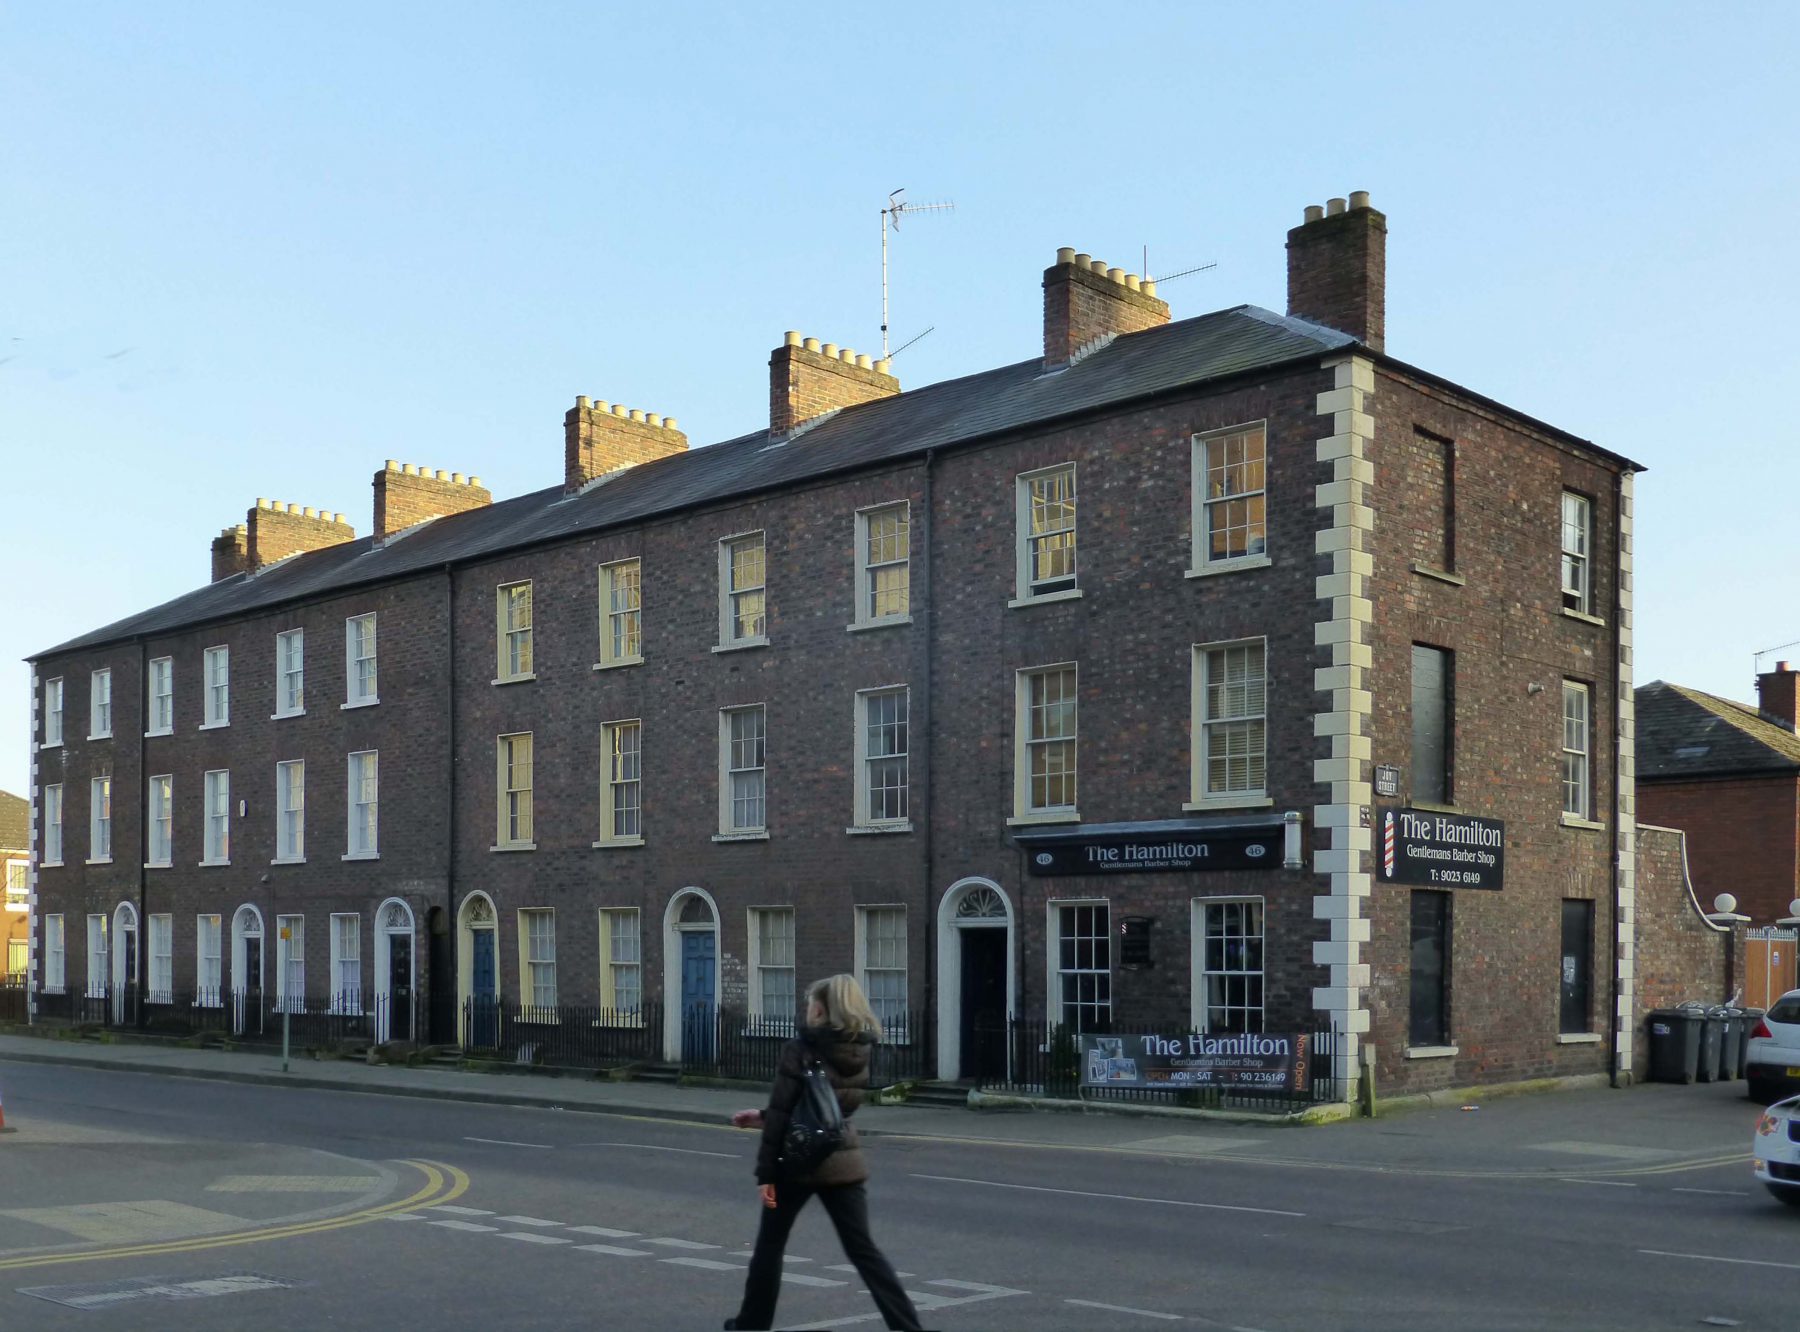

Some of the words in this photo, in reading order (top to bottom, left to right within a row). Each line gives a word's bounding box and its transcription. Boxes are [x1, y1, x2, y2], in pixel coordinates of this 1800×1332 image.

[1382, 771, 1392, 781] JOY
[1378, 781, 1396, 792] STREET
[1400, 813, 1431, 840] The
[1435, 817, 1502, 847] Hamilton
[1086, 846, 1118, 861] The
[1125, 842, 1208, 860] Hamilton
[1248, 845, 1262, 856] 46
[1407, 844, 1451, 860] Gentlemans
[1452, 849, 1476, 863] Barber
[1477, 851, 1495, 867] Shop
[1038, 854, 1051, 864] 46
[1100, 860, 1143, 869] Gentlemans
[1144, 859, 1169, 868] Barber
[1171, 858, 1191, 867] Shop
[1441, 870, 1461, 882] 9023
[1463, 871, 1480, 883] 6149
[1140, 1035, 1182, 1055] The
[1189, 1034, 1289, 1056] Hamilton
[1297, 1034, 1305, 1058] Now
[1215, 1058, 1241, 1066] Barber
[1243, 1058, 1263, 1069] Shop
[1171, 1072, 1190, 1080] MON
[1197, 1072, 1213, 1080] SAT
[1241, 1072, 1252, 1081] 90
[1295, 1061, 1305, 1090] Open
